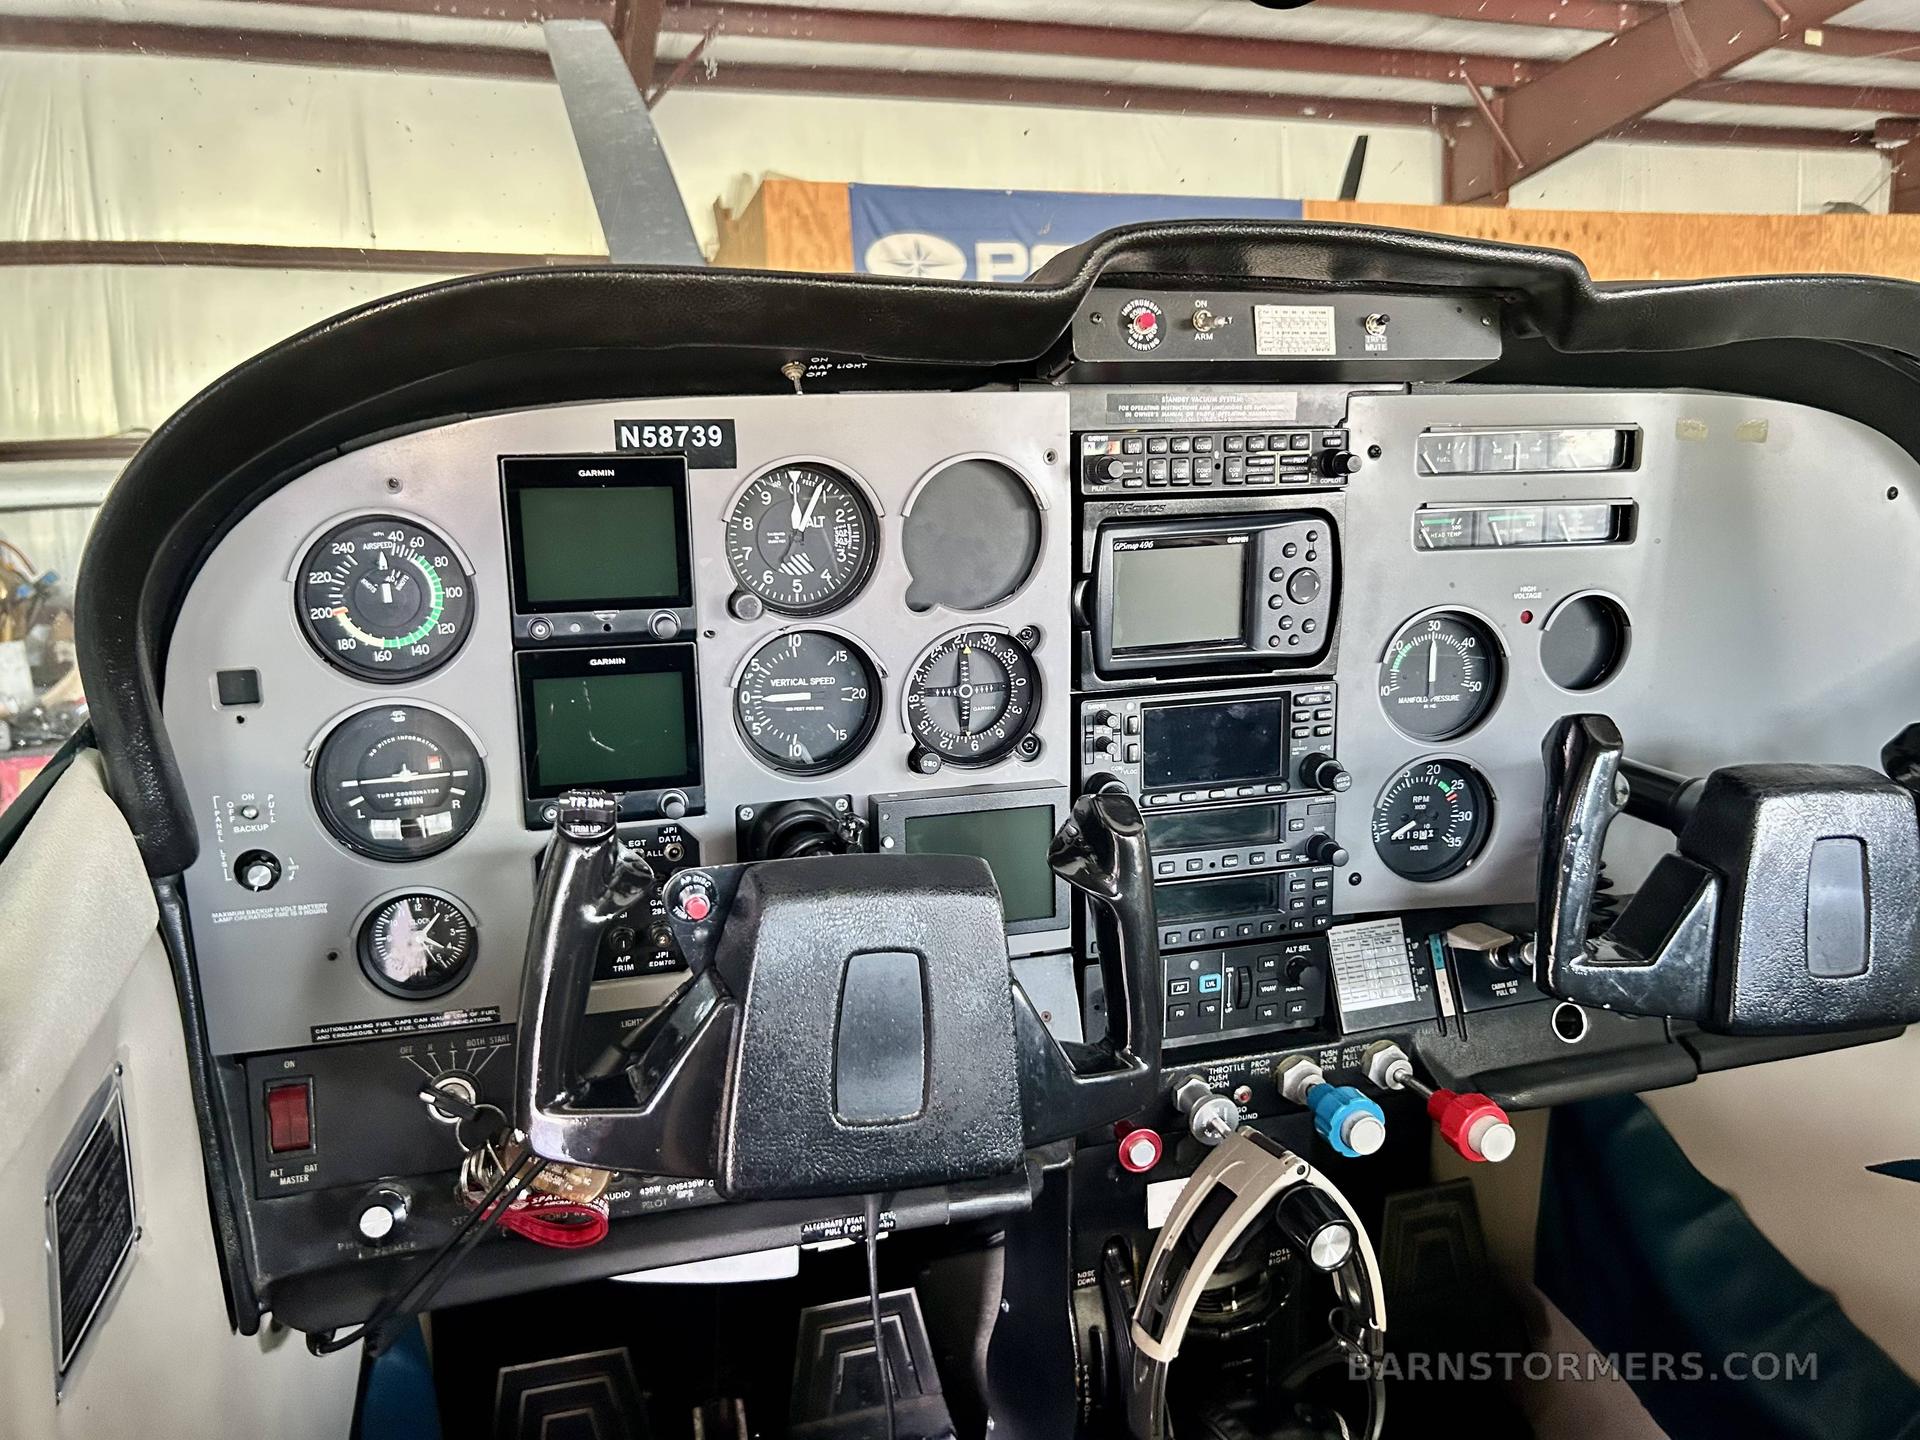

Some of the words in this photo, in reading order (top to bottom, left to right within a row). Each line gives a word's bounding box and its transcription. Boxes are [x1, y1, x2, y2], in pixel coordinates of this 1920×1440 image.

[1121, 299, 1162, 316] INSTRUMENT
[1194, 300, 1208, 308] ON
[1127, 323, 1144, 341] PUMP
[1194, 333, 1214, 341] ARM
[1127, 336, 1160, 351] WARNING
[1365, 343, 1388, 351] MUTE
[620, 425, 723, 448] N58739
[578, 469, 615, 477] GARMIN
[801, 479, 816, 487] FEET
[760, 491, 772, 505] 9
[835, 508, 846, 523] 2
[742, 516, 754, 531] 8
[805, 515, 826, 528] ALT
[387, 531, 405, 542] 40
[409, 536, 425, 548] 60
[332, 542, 355, 553] 240
[363, 541, 393, 550] AIRSPEED
[1113, 541, 1139, 551] GPSmap
[1139, 540, 1154, 549] 496
[741, 546, 753, 561] 7
[836, 551, 847, 563] 3
[434, 556, 449, 567] 80
[309, 572, 332, 583] 220
[762, 569, 774, 585] 6
[820, 568, 832, 581] 4
[792, 579, 803, 593] 5
[445, 586, 463, 598] 100
[310, 608, 333, 620] 200
[437, 623, 456, 634] 120
[1427, 620, 1441, 631] 30
[788, 633, 801, 647] 10
[954, 632, 968, 644] 27
[981, 633, 997, 647] 30
[1461, 637, 1475, 647] 40
[337, 638, 357, 650] 180
[411, 644, 430, 655] 140
[374, 651, 392, 662] 160
[589, 657, 626, 666] GARMIN
[835, 650, 848, 662] 15
[1003, 648, 1019, 665] 33
[750, 658, 761, 672] 5
[770, 678, 809, 687] VERTICAL
[809, 676, 836, 685] SPEED
[1015, 677, 1027, 686] 0
[1468, 681, 1482, 692] 50
[851, 687, 867, 699] 20
[1380, 686, 1390, 696] 10
[741, 690, 750, 704] 0
[908, 694, 920, 710] 18
[1398, 696, 1428, 704] MANIFOLD
[1429, 694, 1460, 702] PRESSURE
[1011, 705, 1023, 715] 3
[752, 722, 762, 736] 5
[917, 720, 932, 736] 15
[995, 727, 1005, 739] 6
[835, 728, 848, 741] 15
[377, 736, 396, 749] PITCH
[397, 735, 439, 752] INFORMATION
[939, 736, 954, 750] 12
[789, 744, 801, 757] 10
[1426, 764, 1441, 775] 20
[1450, 779, 1464, 790] 25
[241, 793, 255, 801] ON
[394, 798, 402, 807] 2
[403, 796, 424, 806] MIN
[569, 797, 604, 808] TRIM
[1412, 795, 1430, 803] RPM
[267, 794, 277, 823] PULL
[452, 799, 461, 809] R
[226, 801, 236, 823] OFF
[357, 809, 366, 819] L
[1457, 811, 1472, 821] 30
[214, 810, 224, 842] PANEL
[232, 823, 270, 833] BACKUP
[570, 824, 588, 833] TRIM
[589, 825, 601, 833] UP
[663, 826, 677, 834] JPI
[628, 839, 647, 847] EGT
[658, 835, 682, 843] DATA
[1447, 836, 1462, 847] 35
[680, 875, 692, 886] AP
[692, 875, 712, 888] DISC
[211, 910, 245, 918] MAXIMUM
[246, 906, 274, 915] BACKUP
[414, 903, 423, 911] 12
[444, 914, 450, 922] 2
[450, 927, 456, 936] 3
[659, 936, 666, 944] 2
[446, 942, 453, 950] 4
[1297, 944, 1311, 952] SEL
[436, 953, 442, 961] 5
[616, 955, 632, 963] A/P
[655, 951, 669, 959] JPI
[612, 963, 635, 972] TRIM
[1264, 960, 1274, 968] IAS
[1491, 981, 1506, 991] CABIN
[1495, 988, 1509, 997] PULL
[1508, 987, 1517, 995] ON
[1175, 1009, 1185, 1017] FD
[1291, 1005, 1302, 1013] ALT
[332, 1028, 379, 1039] ERRONEOUSLY
[400, 1045, 413, 1054] OFF
[466, 1037, 486, 1047] BOTH
[489, 1034, 511, 1045] START
[1342, 1043, 1371, 1054] MIXTURE
[1320, 1049, 1338, 1058] PUSH
[1342, 1053, 1358, 1061] PULL
[283, 1060, 296, 1068] ON
[1250, 1059, 1271, 1068] PROP
[1320, 1056, 1338, 1065] INCR
[1342, 1060, 1361, 1068] LEAN
[1208, 1063, 1246, 1075] THROTTLE
[1250, 1066, 1271, 1076] PITCH
[1208, 1073, 1229, 1083] PUSH
[1208, 1080, 1230, 1090] OPEN
[270, 1167, 284, 1178] ALT
[304, 1163, 319, 1173] BAT
[279, 1174, 310, 1185] MASTER
[603, 1189, 631, 1201] AUDIO
[639, 1185, 662, 1196] 430W
[803, 1218, 843, 1232] ALTERNATE
[824, 1228, 842, 1237] PULL
[849, 1224, 863, 1233] ON
[1268, 1247, 1291, 1259] NOSE
[1268, 1254, 1292, 1266] RIGHT
[1077, 1269, 1095, 1278] NOSE
